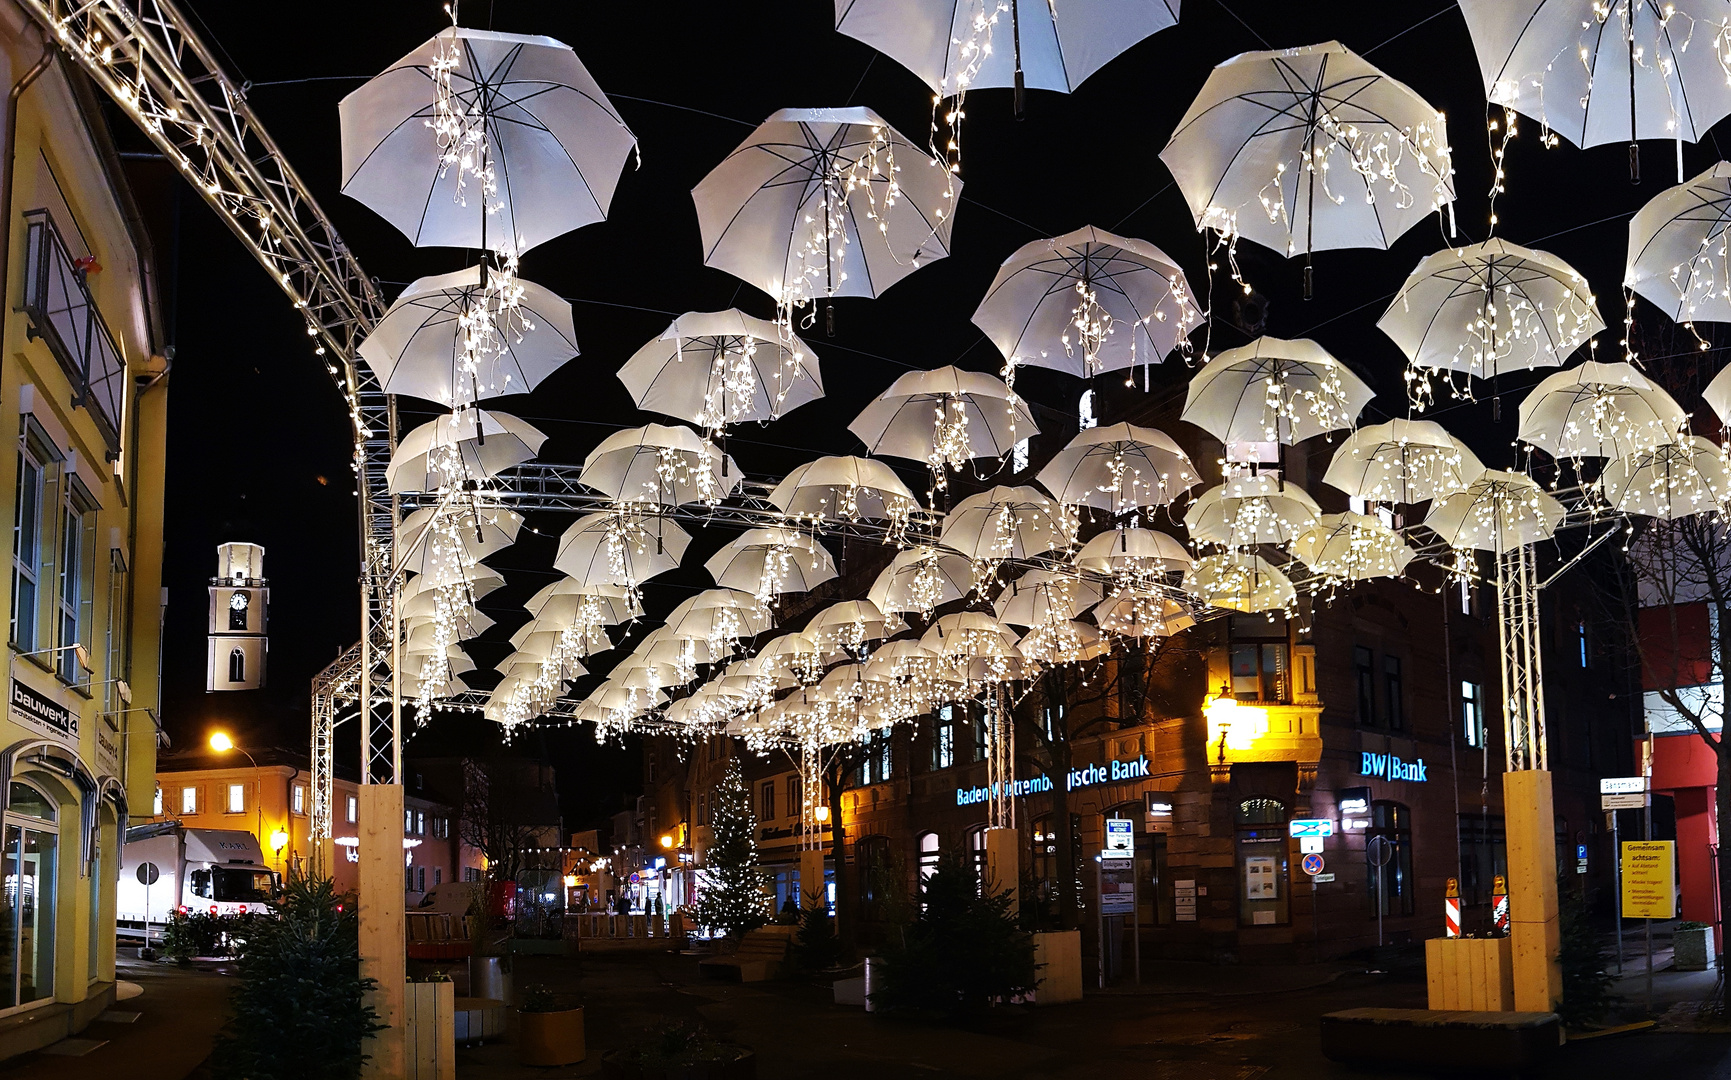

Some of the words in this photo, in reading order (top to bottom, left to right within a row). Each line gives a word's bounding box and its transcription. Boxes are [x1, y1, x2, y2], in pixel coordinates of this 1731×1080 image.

[12, 708, 42, 727] architekten
[14, 684, 68, 728] bauwerk
[70, 719, 78, 734] 4
[1111, 754, 1150, 781] Bank
[219, 841, 250, 851] KARL
